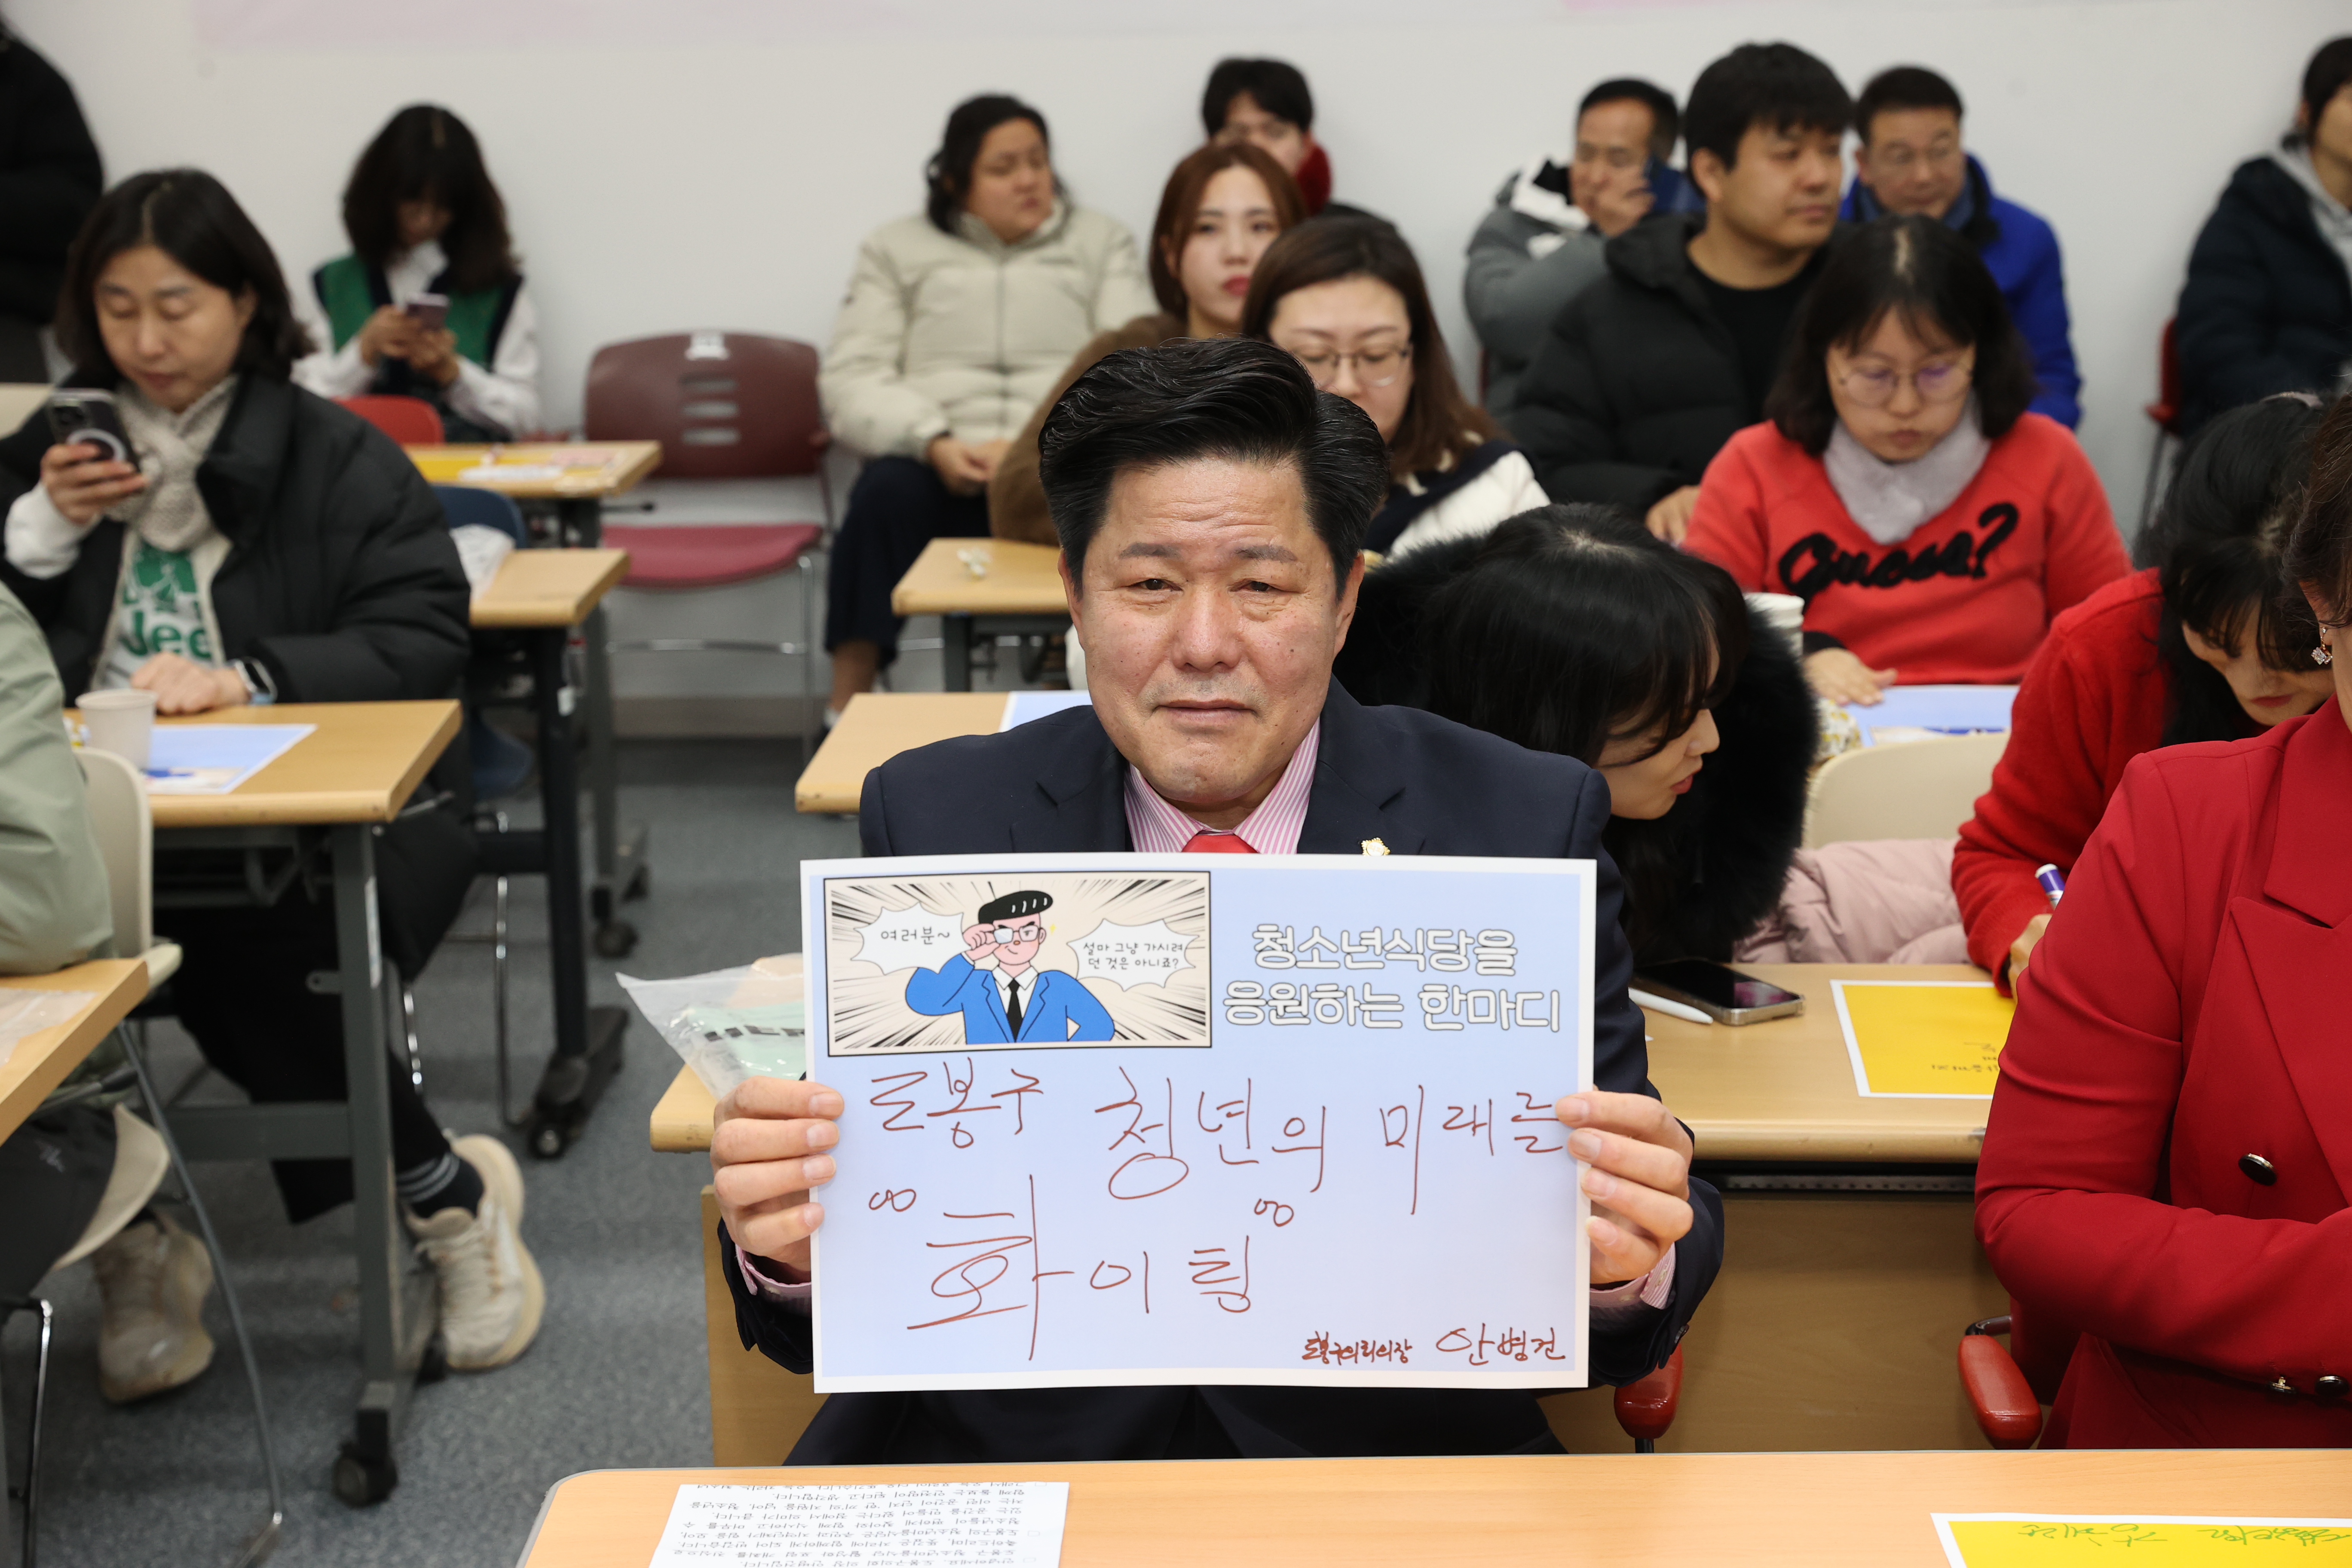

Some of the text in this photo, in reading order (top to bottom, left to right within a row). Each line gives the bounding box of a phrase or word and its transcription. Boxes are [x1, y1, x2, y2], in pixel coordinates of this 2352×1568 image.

[881, 927, 949, 945] 여러분~
[1084, 943, 1182, 956] 설마 그냥 가시려
[1252, 924, 1518, 977] 청소년식당을
[1088, 957, 1179, 970] 던 것은 아니죠?
[1223, 980, 1560, 1033] 응원하는 한마디
[870, 1057, 1562, 1216] 도봉구 청년의 미래를
[1436, 1323, 1566, 1366] 안병건
